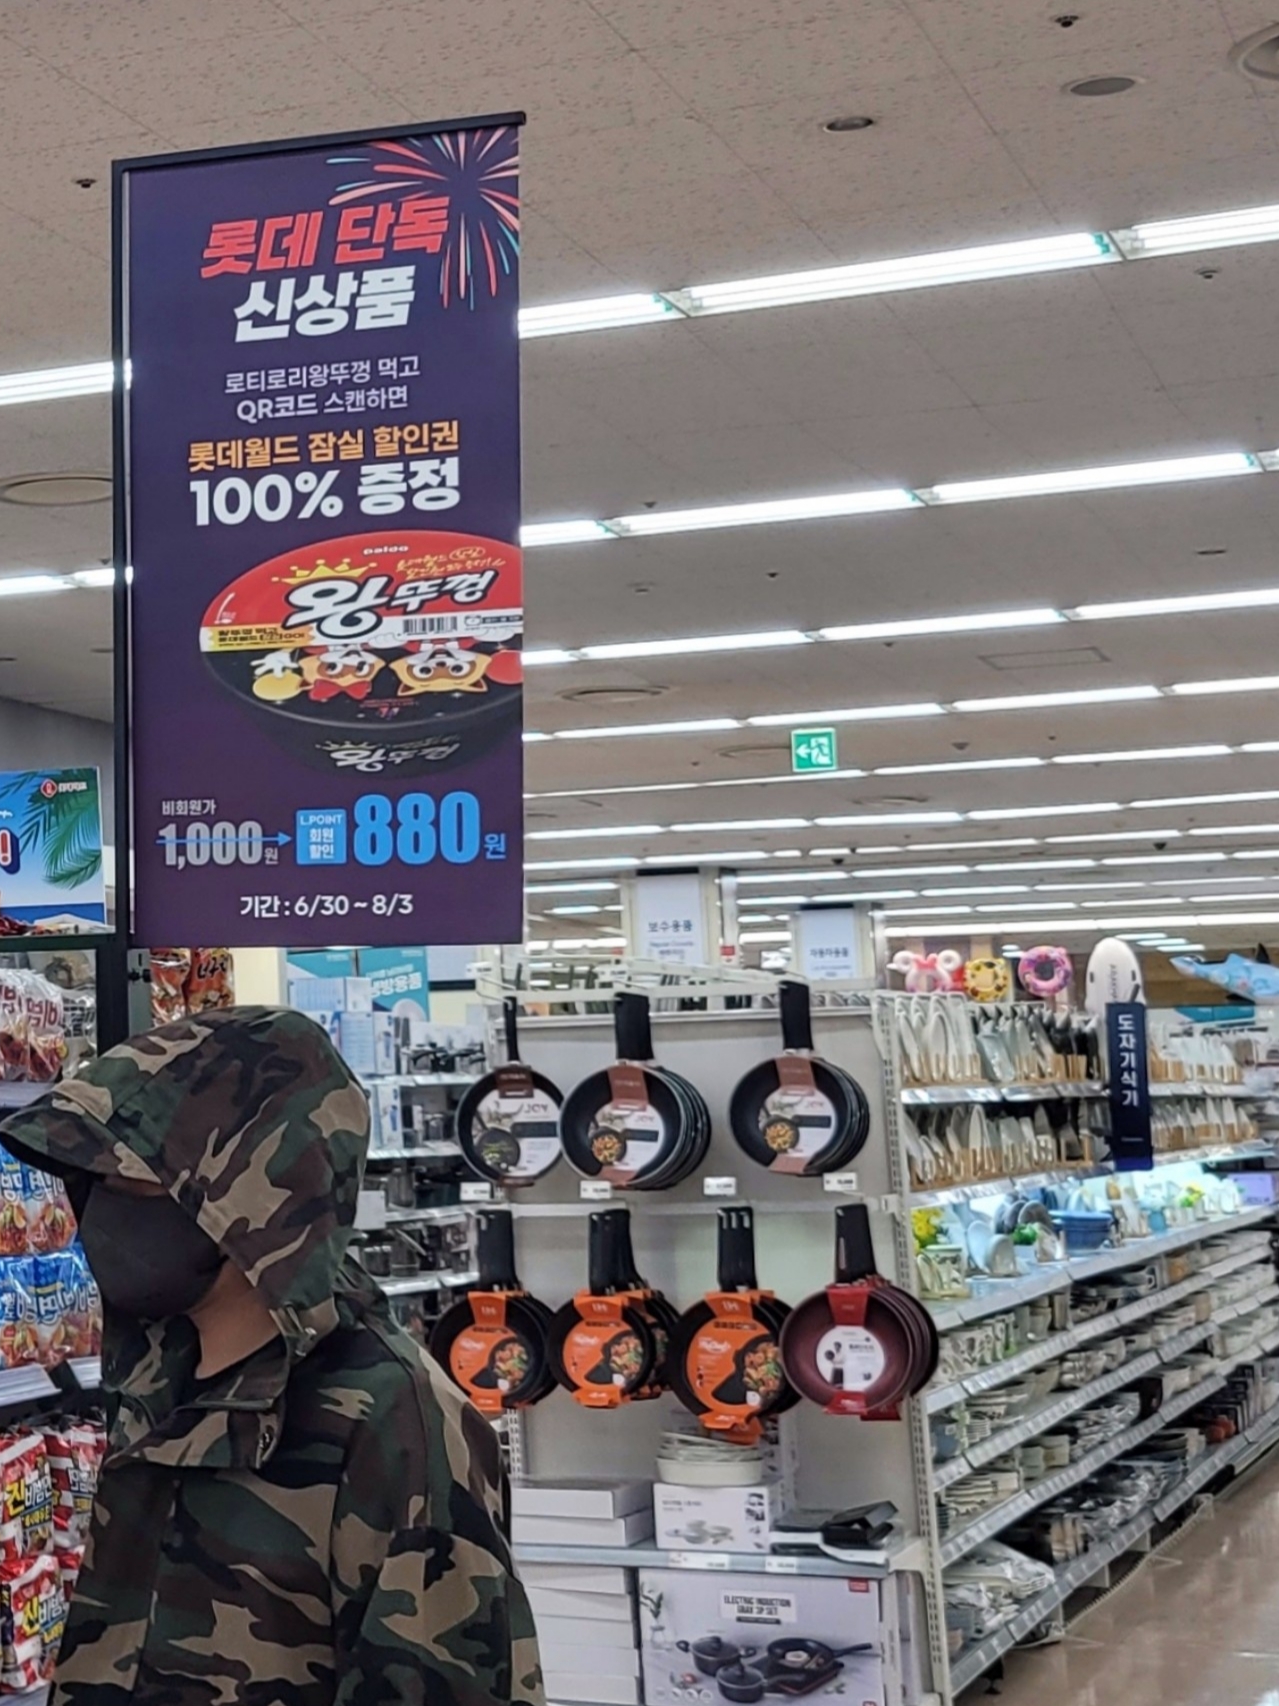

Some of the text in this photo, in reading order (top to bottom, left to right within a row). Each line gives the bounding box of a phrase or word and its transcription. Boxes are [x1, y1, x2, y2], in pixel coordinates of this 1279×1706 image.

[200, 197, 449, 278] 롯데 단독
[234, 265, 415, 343] 신상품
[225, 357, 419, 395] 로티로리왕뚜껑 먹고
[237, 386, 408, 424] QR코드 스캔하면
[188, 421, 460, 472] 롯데월드 잠실 할인권
[190, 457, 461, 525] 100% 증정
[285, 570, 495, 638] 왕뚜껑
[162, 799, 216, 816] 비회원가
[300, 814, 344, 825] L.POINT
[309, 828, 334, 843] 회원
[309, 845, 334, 860] 할인
[294, 895, 349, 917] 6/30
[372, 894, 414, 916] 8/3
[1117, 1013, 1140, 1108] 도자기식기
[723, 1594, 754, 1607] ELECTRIC
[755, 1597, 792, 1609] INDUCTION
